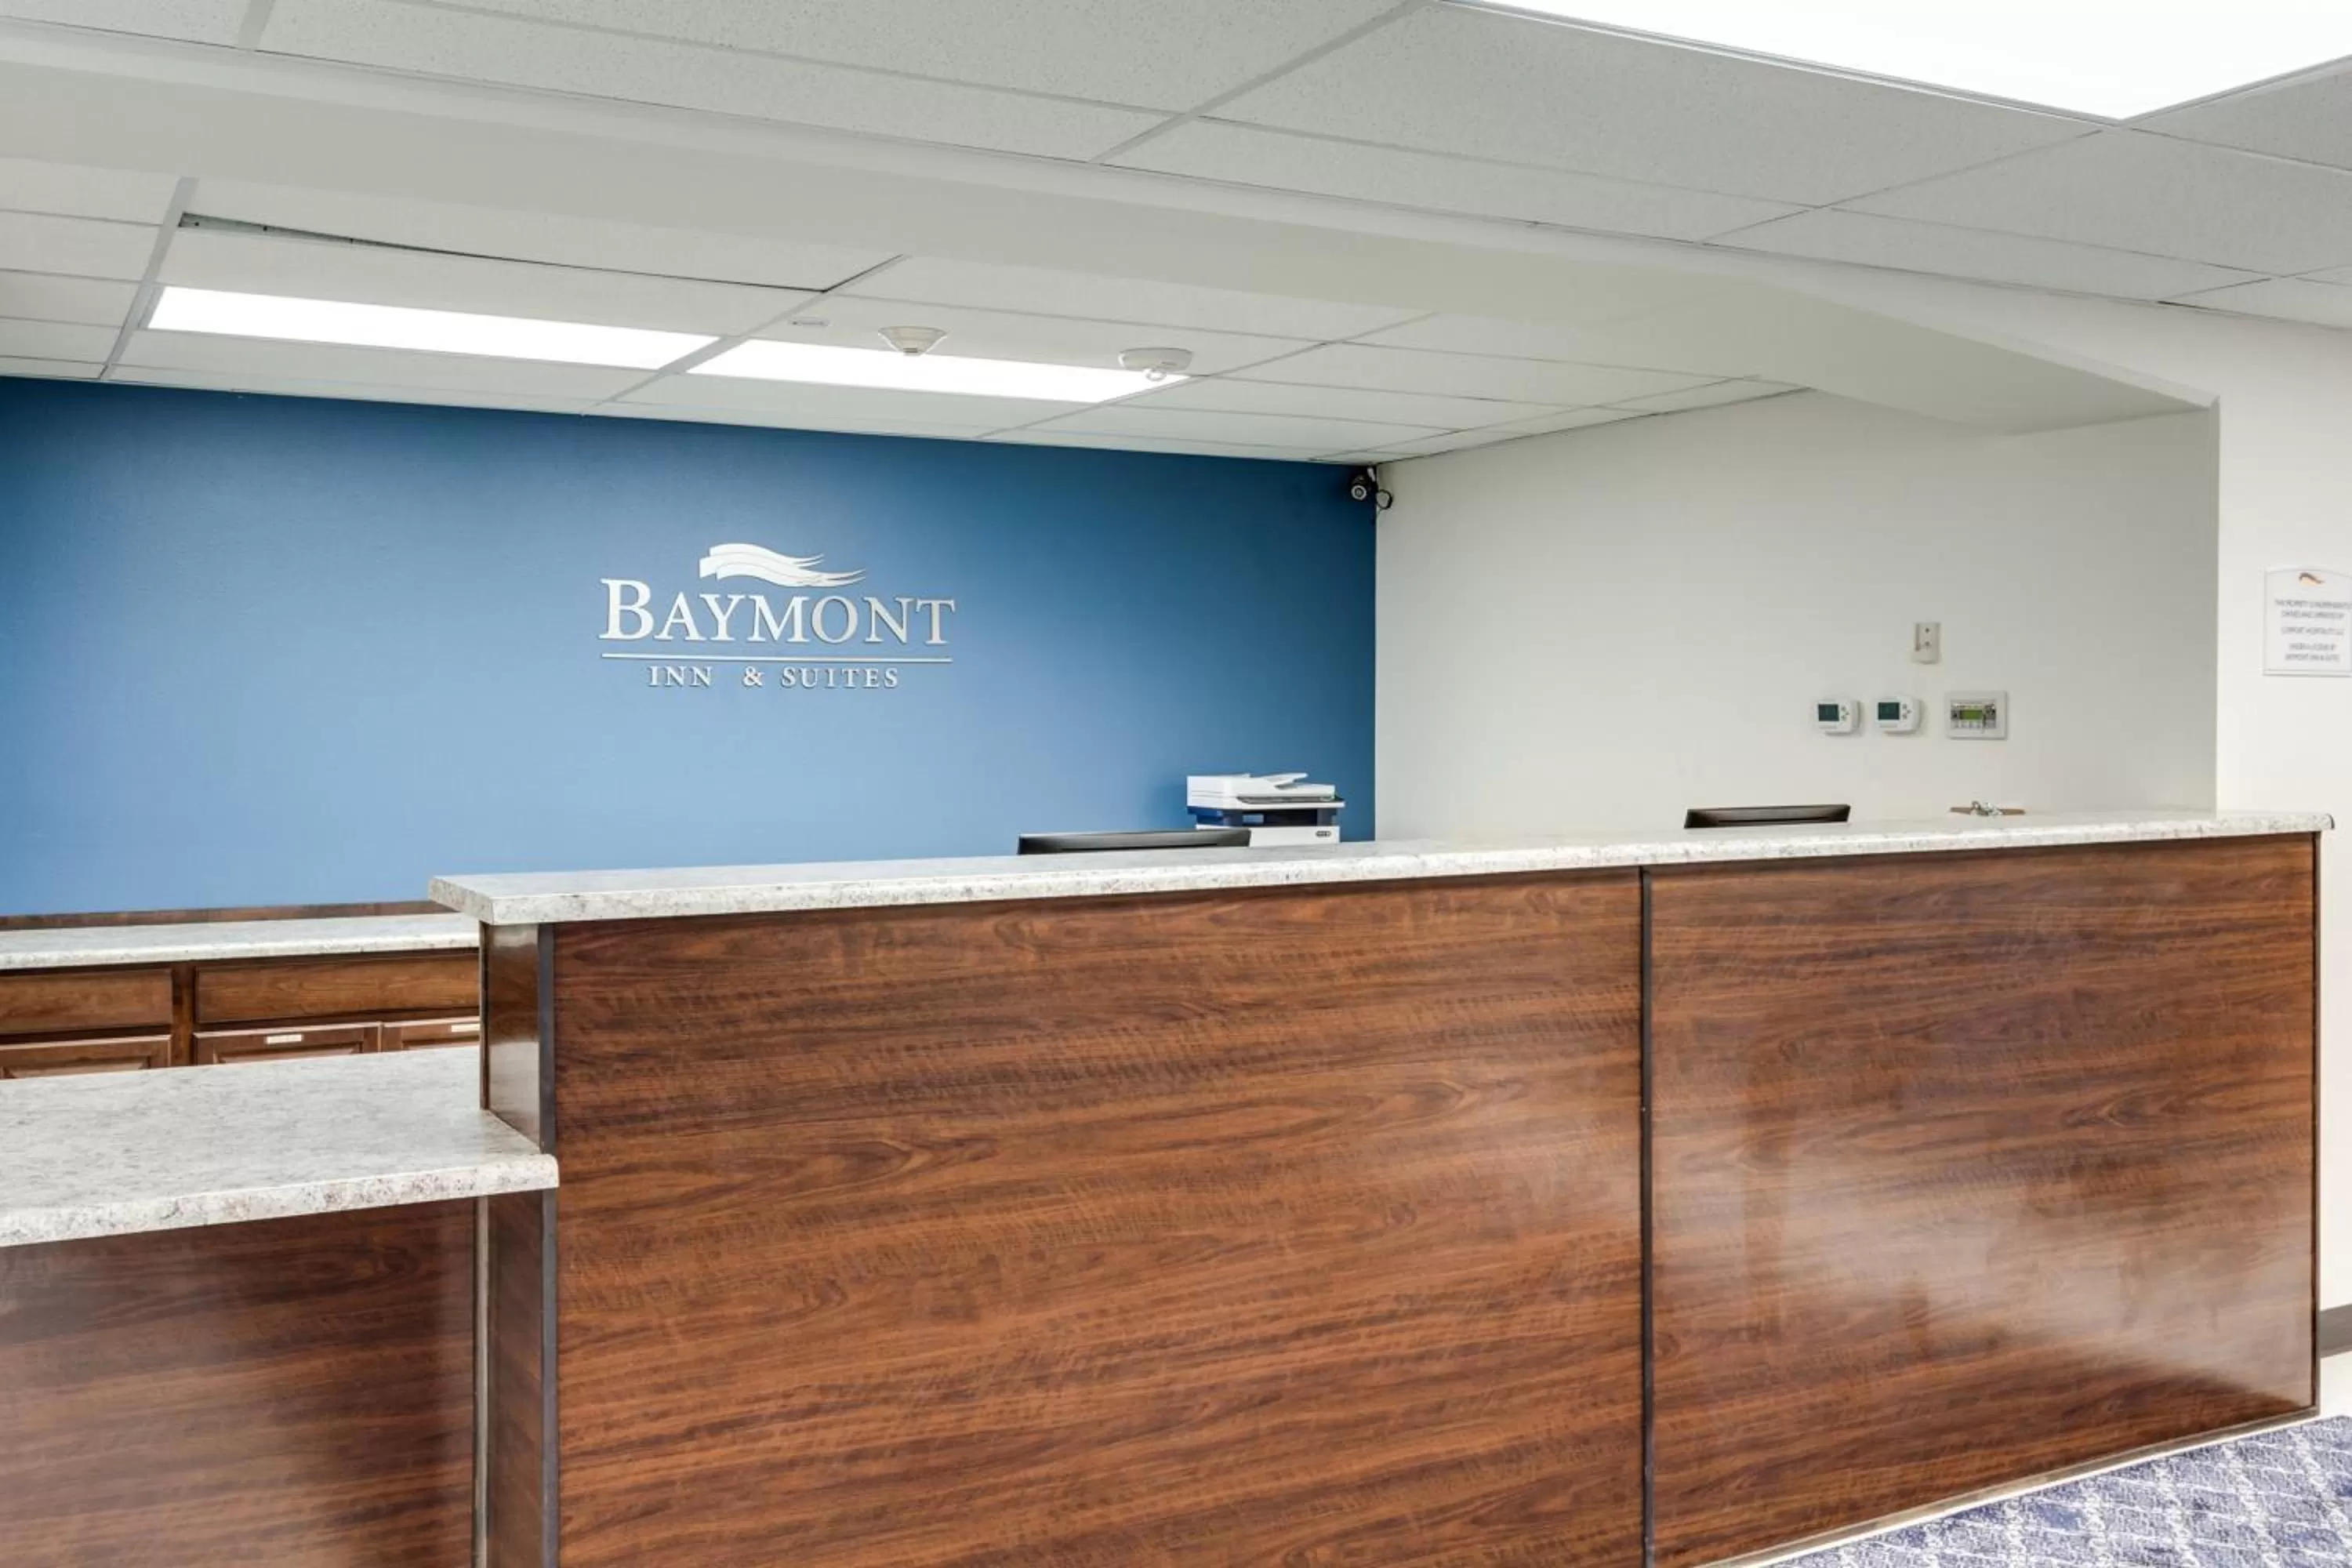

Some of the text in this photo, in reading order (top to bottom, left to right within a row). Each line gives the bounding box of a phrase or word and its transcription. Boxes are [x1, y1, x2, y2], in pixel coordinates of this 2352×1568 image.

[599, 578, 955, 644] BAYMONT
[648, 666, 899, 688] INN & SUITES
